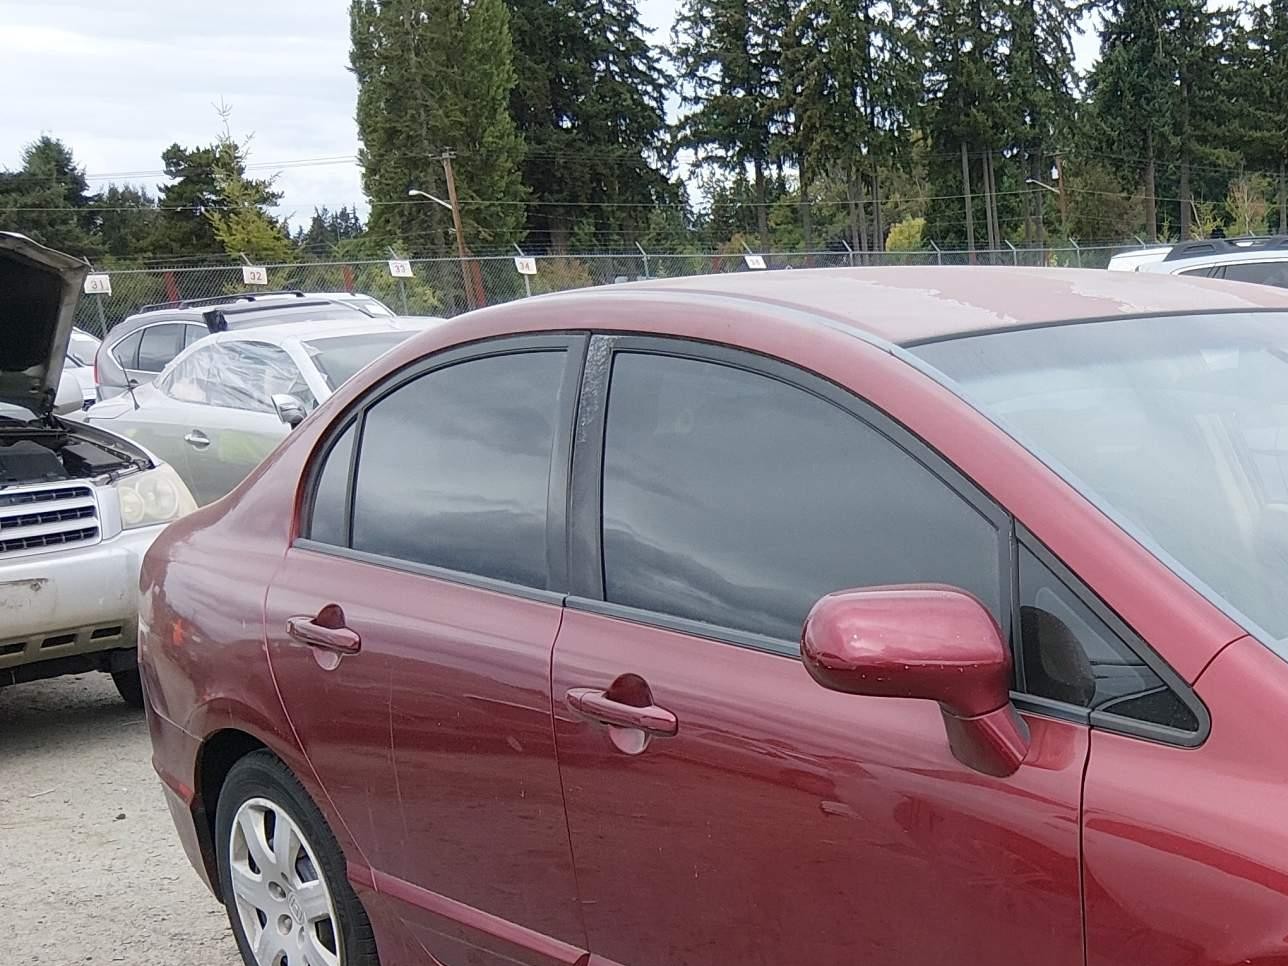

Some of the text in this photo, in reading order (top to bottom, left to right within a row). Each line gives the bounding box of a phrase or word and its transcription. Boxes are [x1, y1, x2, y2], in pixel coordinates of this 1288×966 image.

[394, 262, 406, 273] 33
[519, 261, 530, 271] 34
[249, 271, 262, 281] 32
[90, 279, 104, 290] 31
